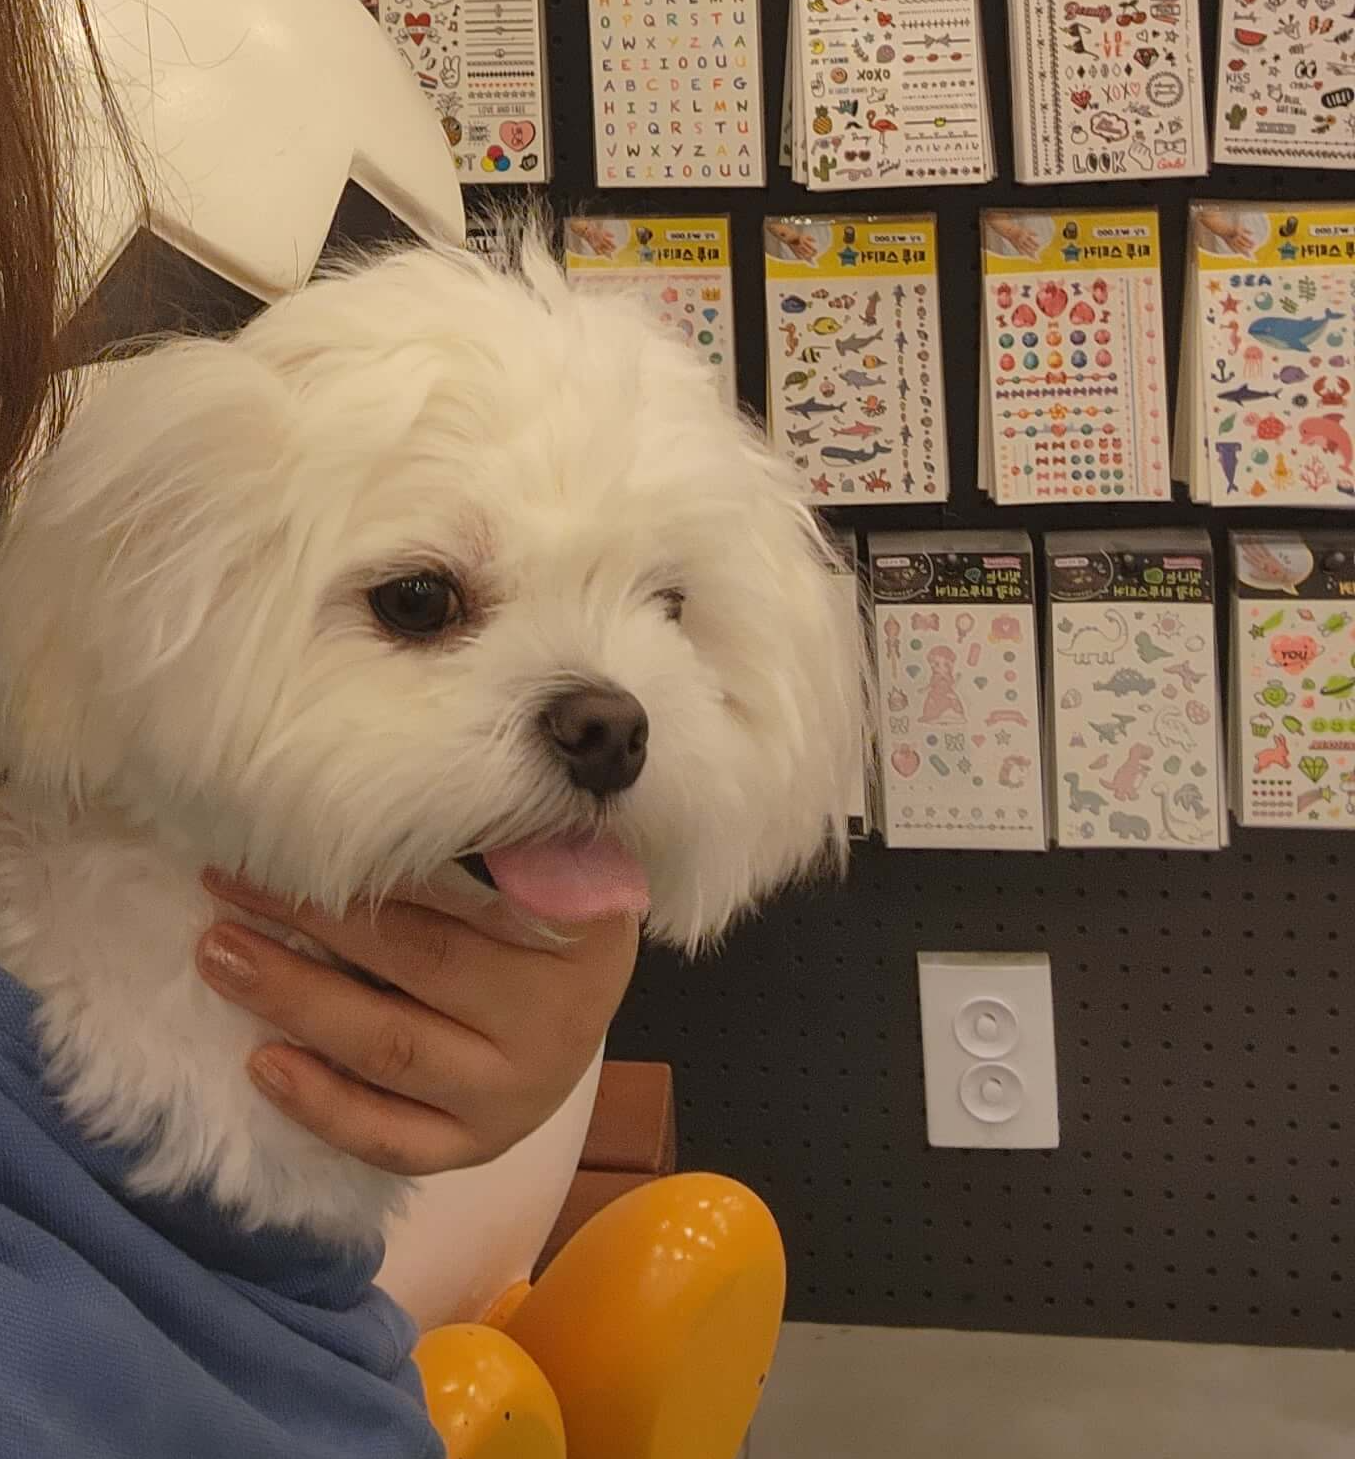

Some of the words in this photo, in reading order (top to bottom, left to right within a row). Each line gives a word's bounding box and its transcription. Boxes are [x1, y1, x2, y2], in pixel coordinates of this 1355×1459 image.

[622, 14, 632, 27] P
[643, 14, 655, 26] Q
[667, 13, 677, 26] R
[691, 13, 698, 26] S
[711, 12, 722, 25] T
[733, 12, 745, 25] U
[602, 36, 611, 51] V
[622, 37, 635, 50] W
[646, 37, 656, 49] X
[668, 37, 679, 48] Y
[689, 37, 700, 48] Z
[712, 36, 723, 48] A
[735, 35, 745, 47] A
[603, 59, 612, 71] E
[621, 59, 631, 70] E
[716, 55, 727, 68] U
[735, 56, 746, 68] U
[857, 68, 891, 82] XOXO
[604, 80, 615, 92] A
[626, 80, 635, 92] B
[647, 79, 659, 91] C
[670, 79, 679, 91] D
[691, 78, 701, 91] E
[713, 78, 723, 90] F
[734, 77, 747, 90] G
[604, 102, 614, 114] H
[649, 101, 657, 113] J
[670, 100, 680, 112] K
[693, 101, 702, 112] L
[714, 101, 726, 112] M
[737, 100, 747, 112] N
[627, 122, 637, 135] P
[648, 122, 660, 134] Q
[671, 121, 681, 134] R
[694, 122, 702, 133] S
[715, 121, 726, 134] T
[737, 120, 748, 134] U
[1072, 150, 1127, 174] LOOK
[1229, 274, 1272, 288] SEA
